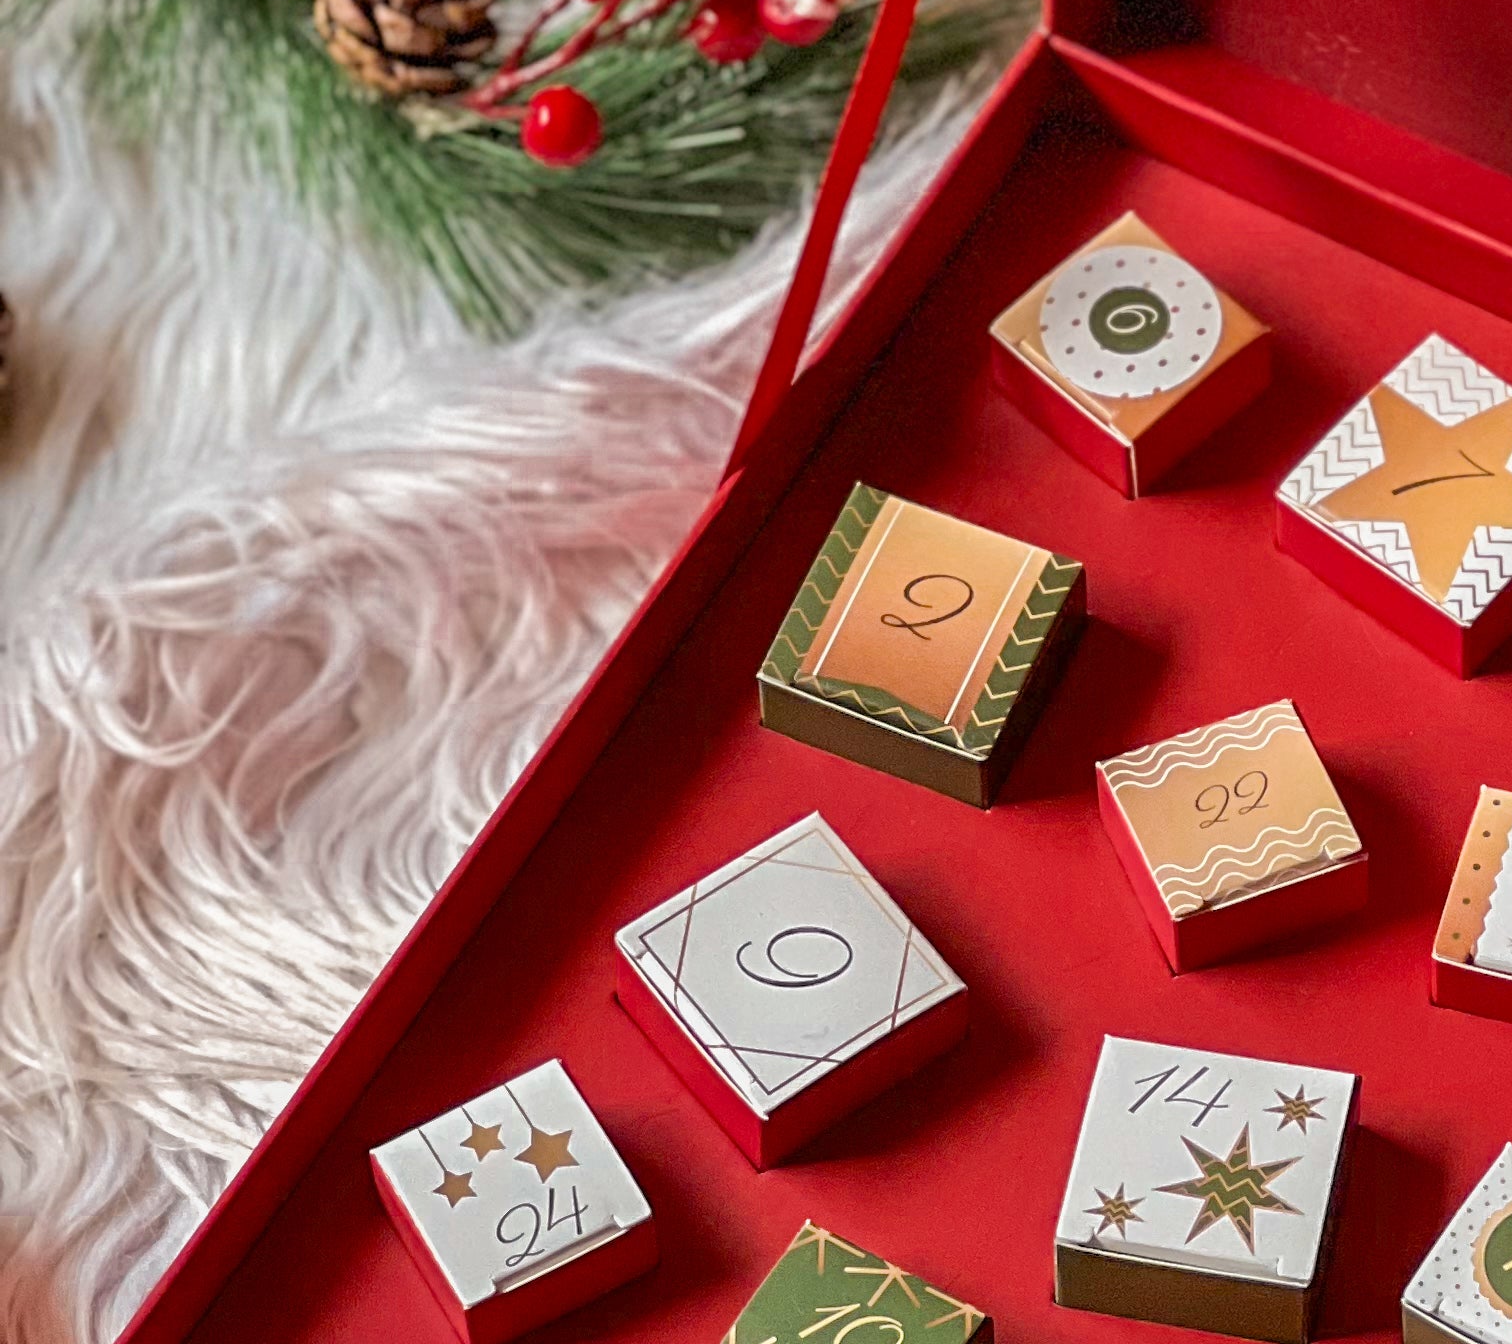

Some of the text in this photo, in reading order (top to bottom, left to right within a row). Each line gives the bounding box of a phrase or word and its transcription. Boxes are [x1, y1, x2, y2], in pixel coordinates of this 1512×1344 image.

[1107, 305, 1158, 334] 6
[1393, 450, 1495, 495] 7
[881, 574, 973, 640] 2
[1196, 771, 1268, 829] 22
[1128, 1065, 1233, 1128] 14
[496, 1185, 588, 1267] 24
